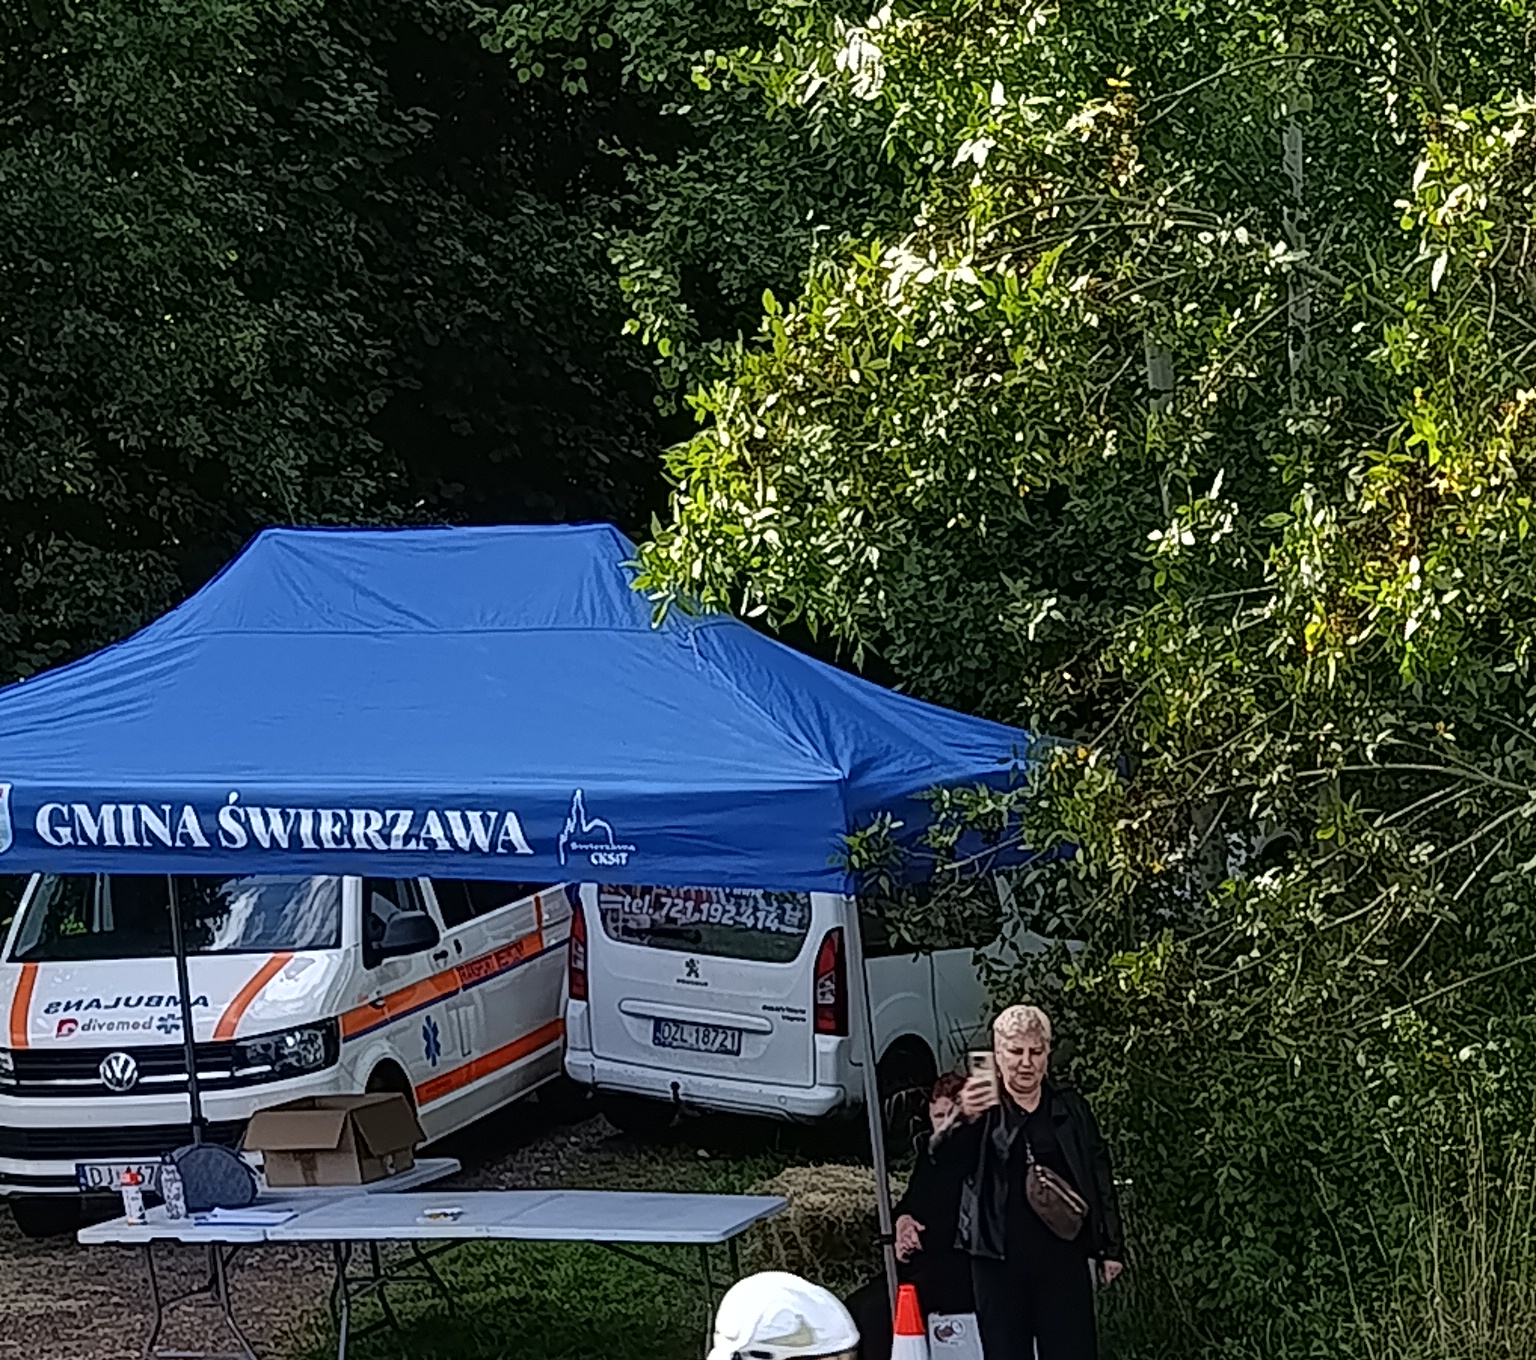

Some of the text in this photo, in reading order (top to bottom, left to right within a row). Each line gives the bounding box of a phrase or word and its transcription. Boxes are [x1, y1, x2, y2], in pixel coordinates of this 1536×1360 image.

[36, 791, 535, 854] GMINA ŚWIERZAWA
[700, 902, 737, 925] 192
[695, 1027, 736, 1050] 18721
